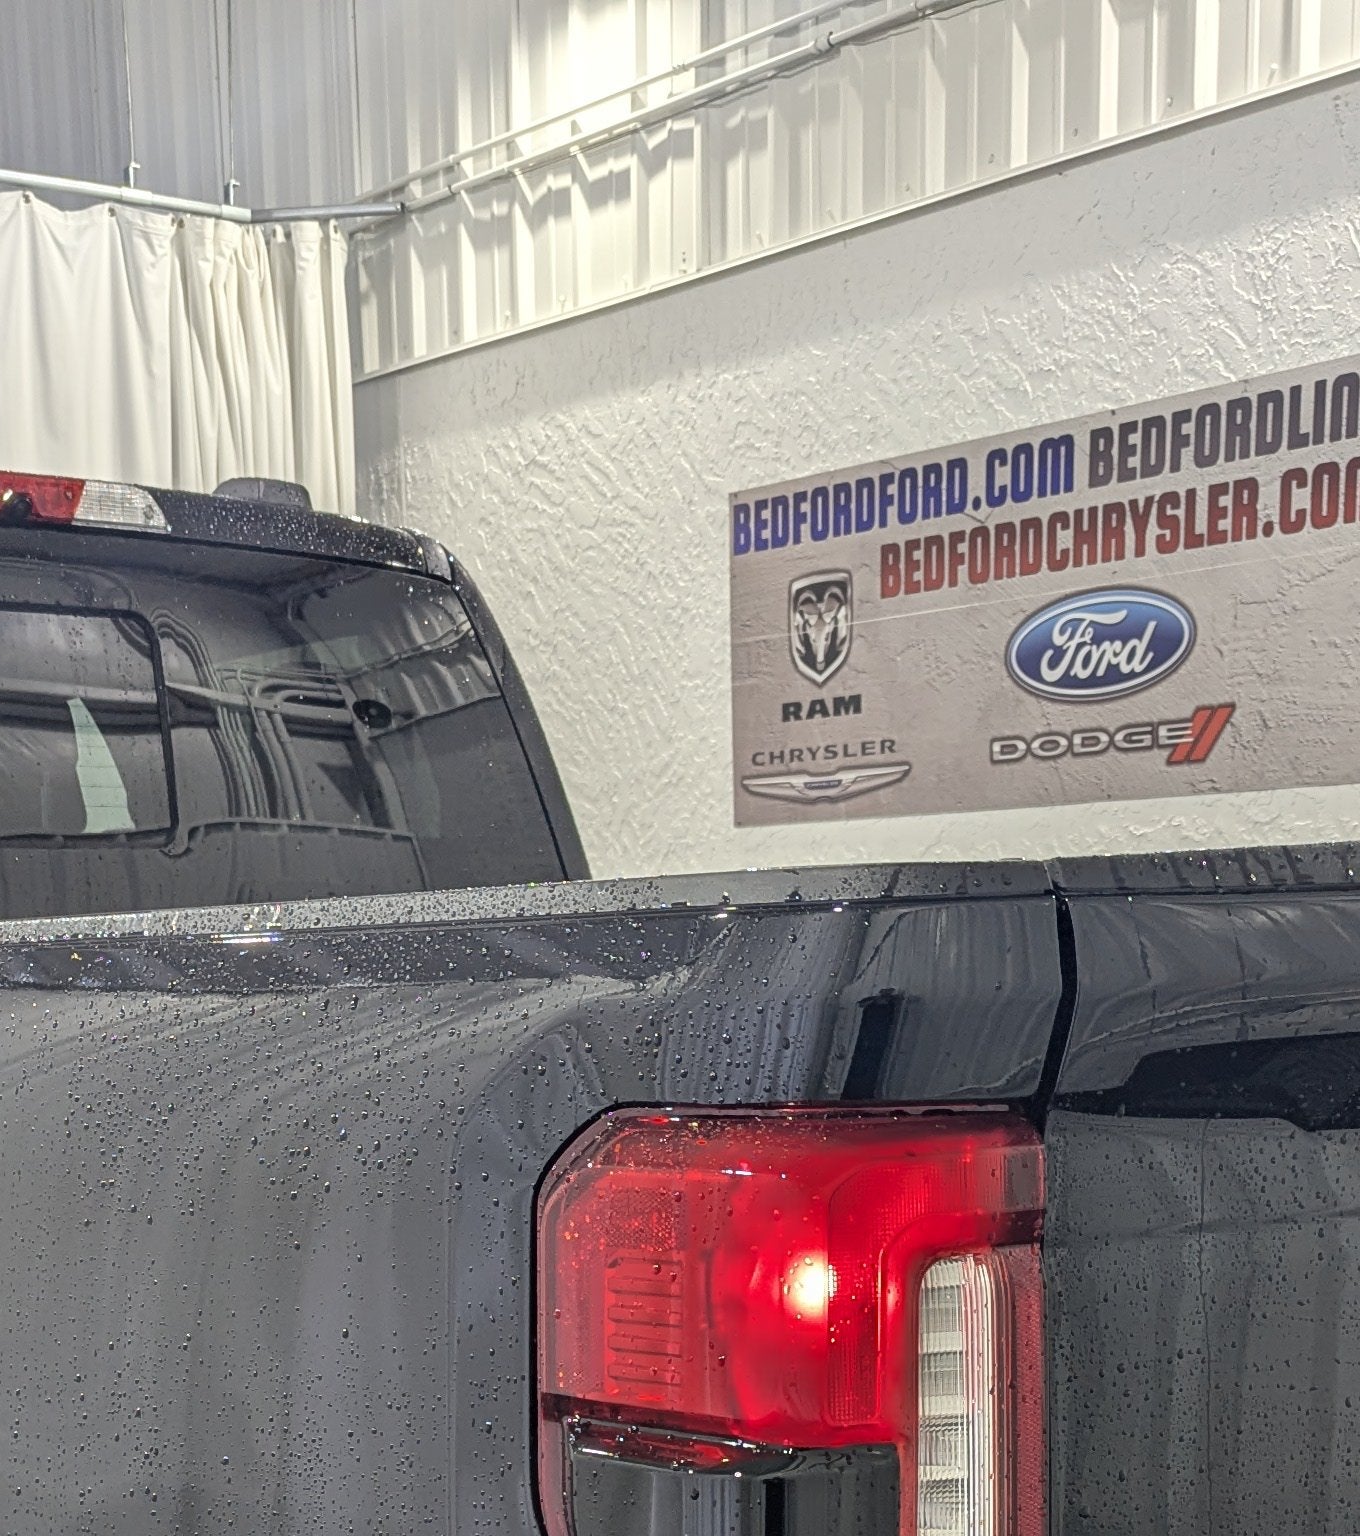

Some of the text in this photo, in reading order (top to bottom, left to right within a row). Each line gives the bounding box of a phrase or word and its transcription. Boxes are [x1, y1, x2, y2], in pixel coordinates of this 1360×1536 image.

[733, 434, 1075, 556] BEDFORDFORD.COM
[1040, 609, 1157, 683] Ford
[781, 694, 862, 723] RAM
[751, 739, 897, 767] CHRYSLER
[991, 721, 1194, 762] DODGE
